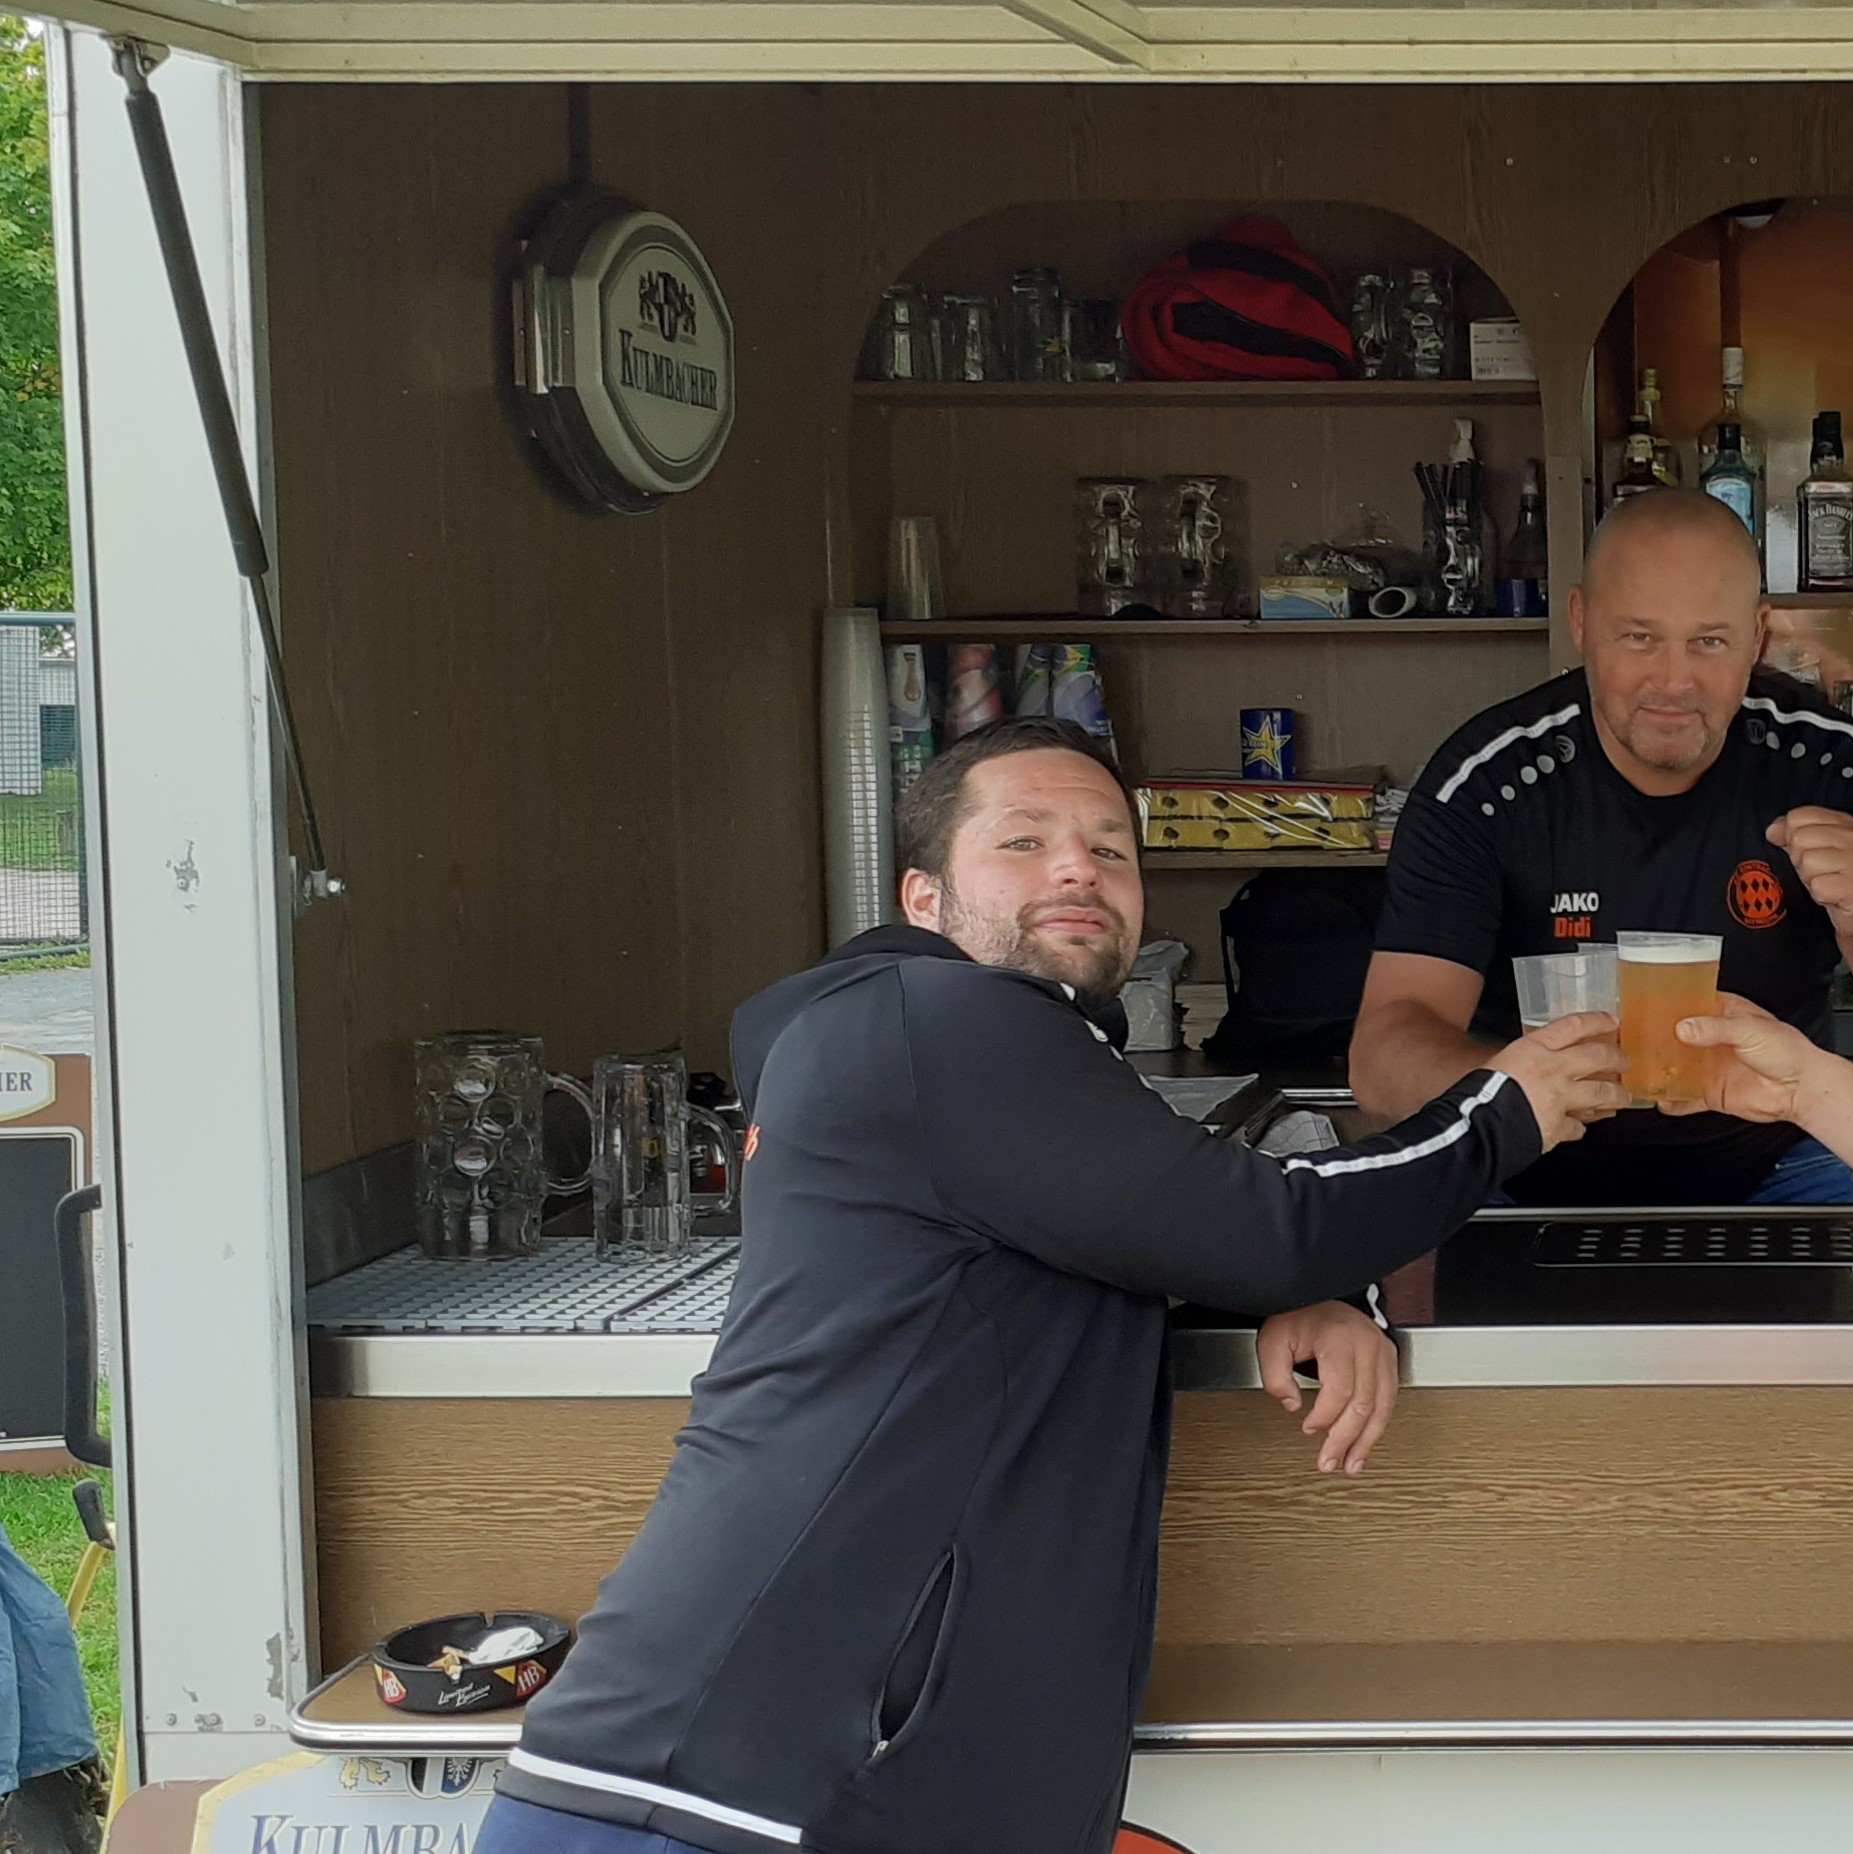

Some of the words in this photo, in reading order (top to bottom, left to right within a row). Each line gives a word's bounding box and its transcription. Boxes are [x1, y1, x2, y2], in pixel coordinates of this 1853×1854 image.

[619, 328, 719, 411] KULMBACHER
[1551, 892, 1599, 913] JAKO
[1555, 917, 1591, 938] Didi
[383, 1679, 399, 1699] HB
[517, 1665, 541, 1692] HB
